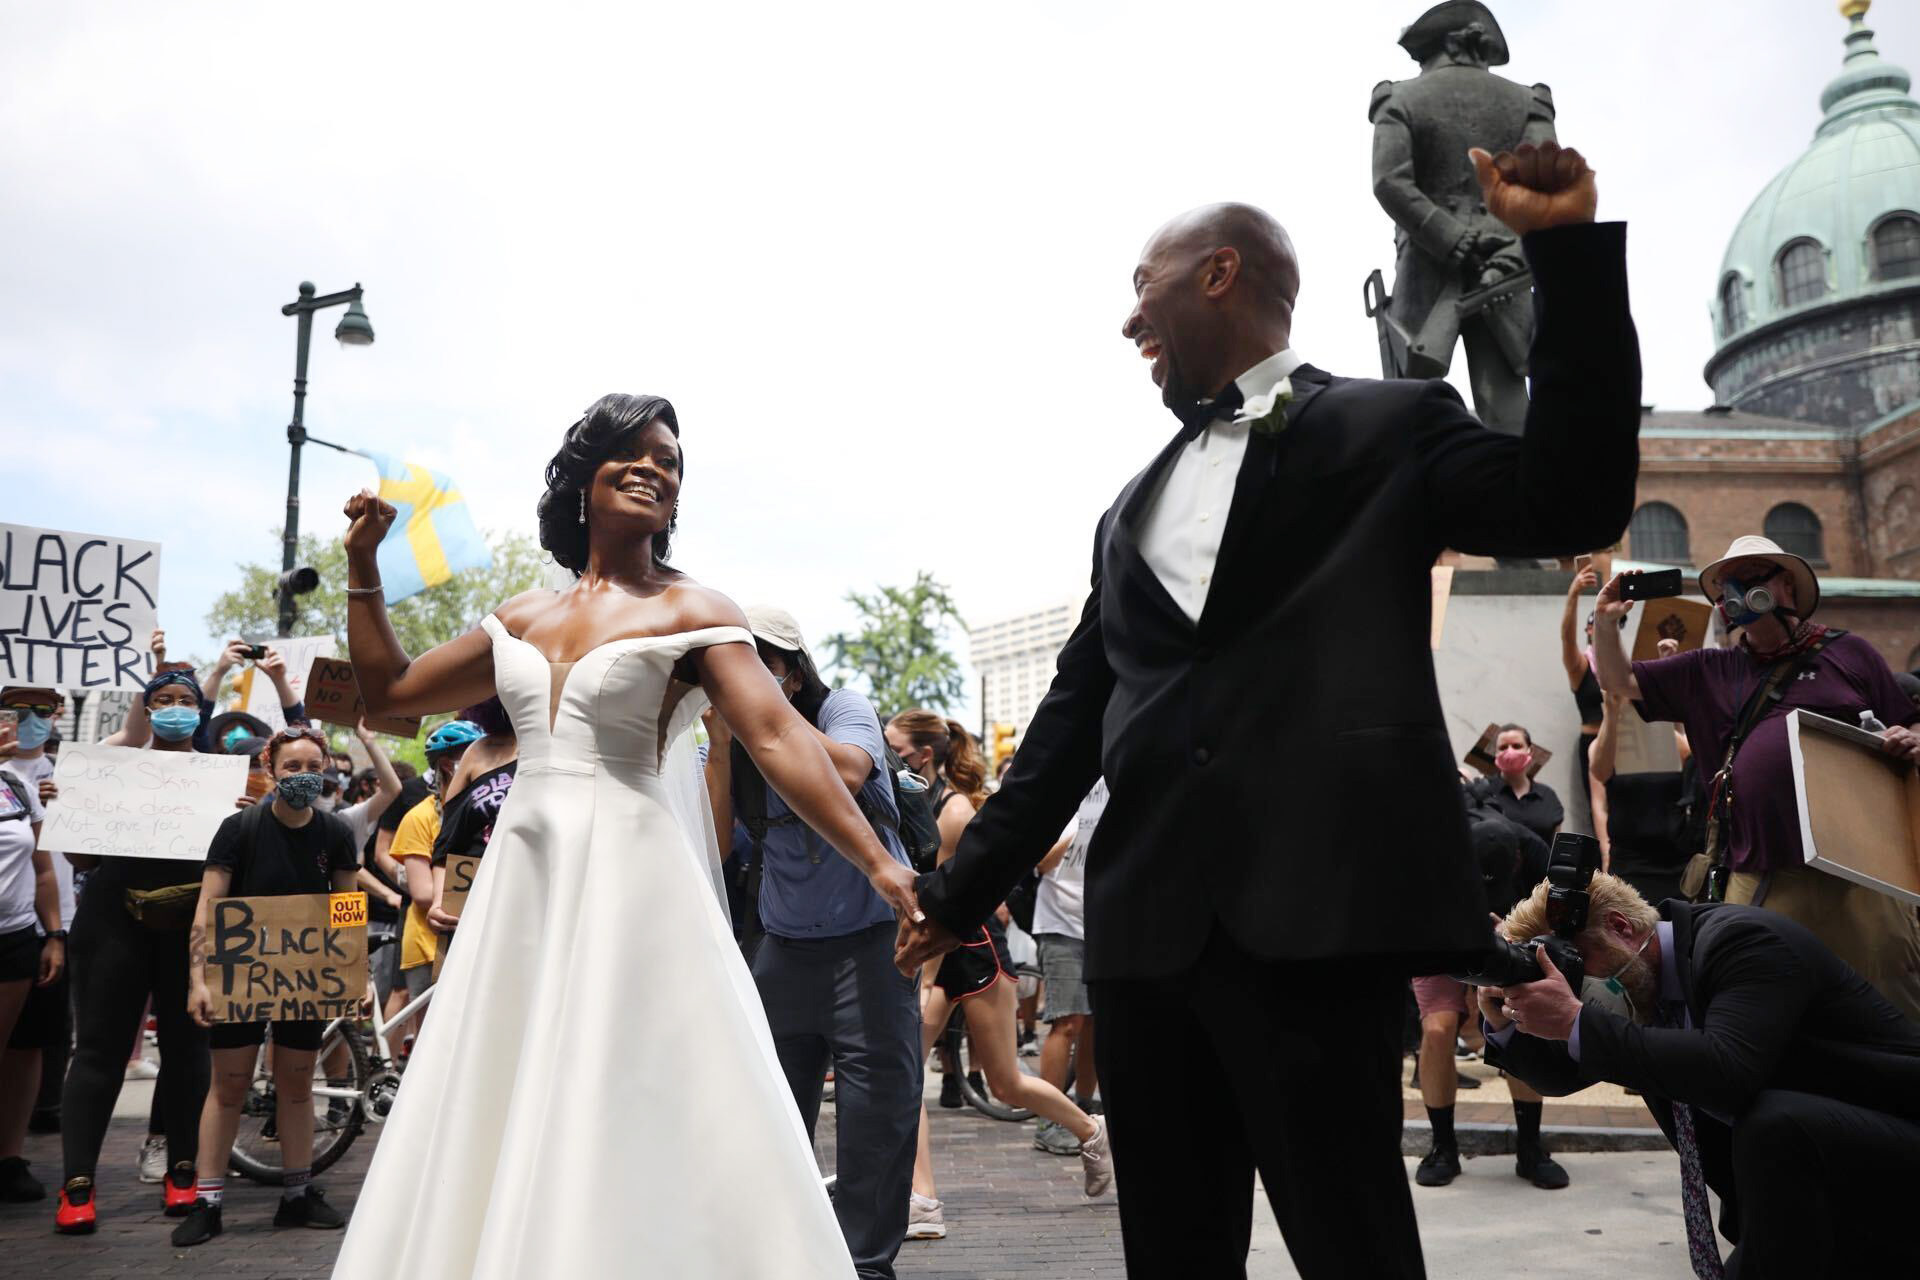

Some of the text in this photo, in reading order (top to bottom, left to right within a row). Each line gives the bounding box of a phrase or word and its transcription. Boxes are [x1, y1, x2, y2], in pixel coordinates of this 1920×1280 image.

[0, 531, 156, 609] LACK
[315, 687, 343, 704] NO
[50, 811, 95, 832] Not
[335, 900, 361, 911] OUT
[333, 910, 365, 923] NOW
[215, 901, 346, 958] BLACK
[207, 954, 346, 998] TRANS
